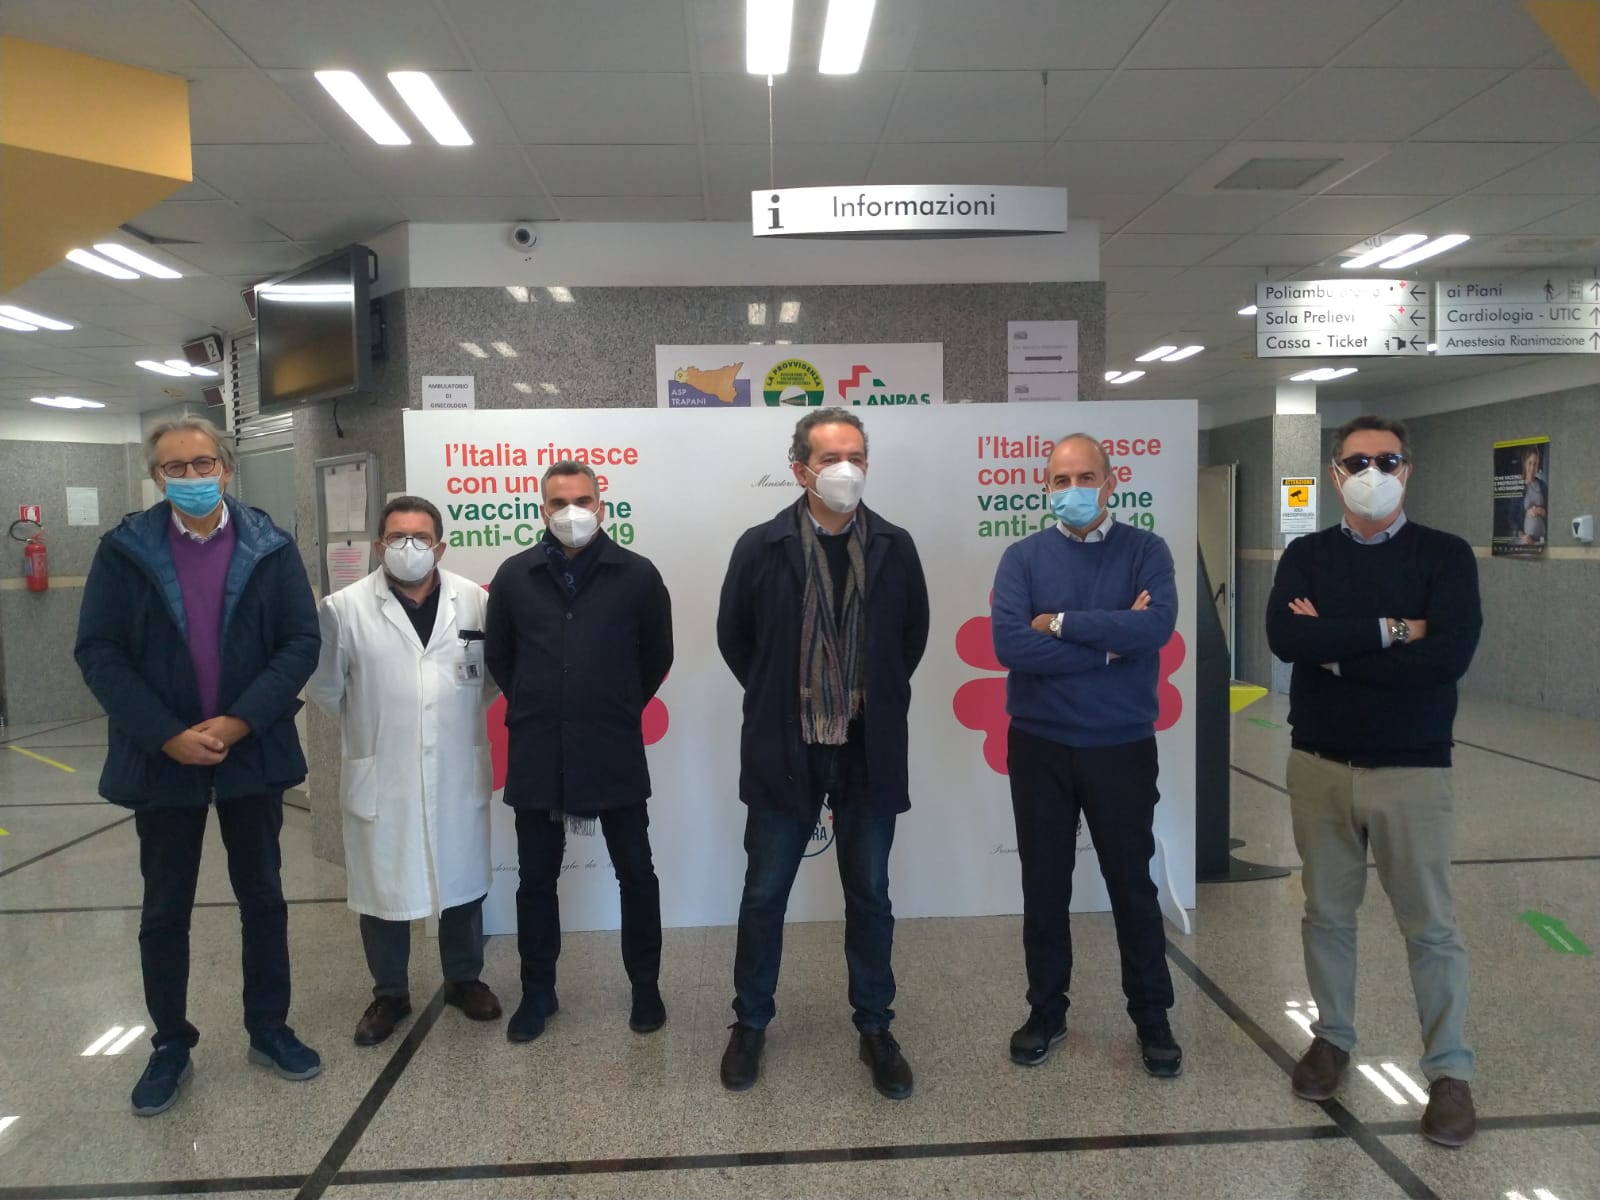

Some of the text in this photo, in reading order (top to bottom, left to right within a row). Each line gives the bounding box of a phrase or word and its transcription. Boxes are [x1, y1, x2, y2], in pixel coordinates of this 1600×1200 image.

[767, 192, 996, 229] i Informazioni
[1265, 286, 1380, 300] Poliambuo
[1447, 284, 1503, 298] ai Piani
[1265, 310, 1355, 325] Sala Prelievi
[1447, 308, 1534, 325] Cardiologia
[1550, 307, 1582, 321] UTIC
[1265, 336, 1311, 350] Cassa
[1327, 335, 1369, 348] Ticket
[1446, 334, 1585, 348] Anestesia Rianimazione
[208, 343, 217, 357] 2
[773, 361, 821, 387] PROVVIDENZA
[671, 388, 687, 396] ASP
[867, 393, 931, 405] ANPAS
[671, 398, 707, 406] TRAPANI
[1103, 437, 1162, 456] asce
[445, 442, 639, 467] l'Italia rinasce
[977, 467, 1048, 486] con u
[446, 475, 539, 495] con un
